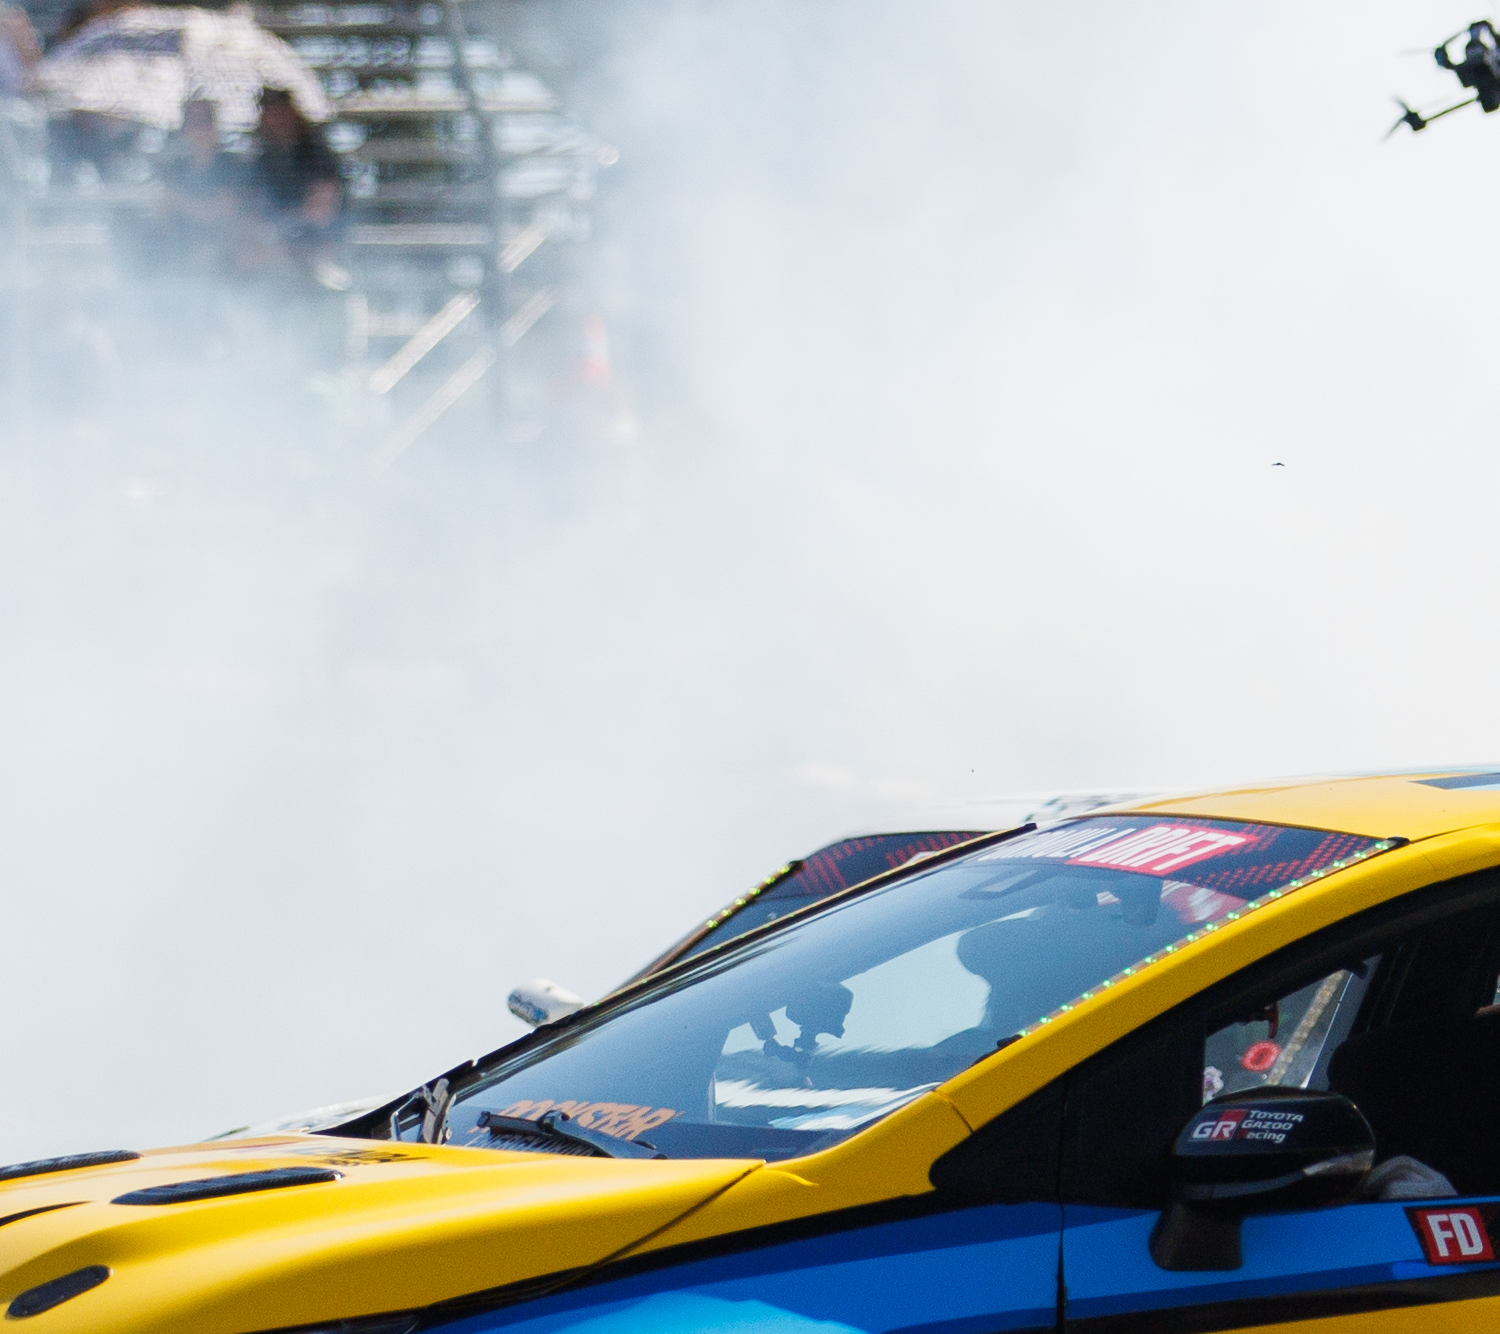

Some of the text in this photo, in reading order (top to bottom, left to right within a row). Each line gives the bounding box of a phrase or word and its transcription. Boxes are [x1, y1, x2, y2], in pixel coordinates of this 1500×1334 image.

[1077, 825, 1247, 871] DRIFT
[1241, 1119, 1294, 1131] GAZOO
[1249, 1110, 1304, 1123] TOYOTA
[1192, 1120, 1238, 1140] GR
[1426, 1213, 1484, 1258] FD
